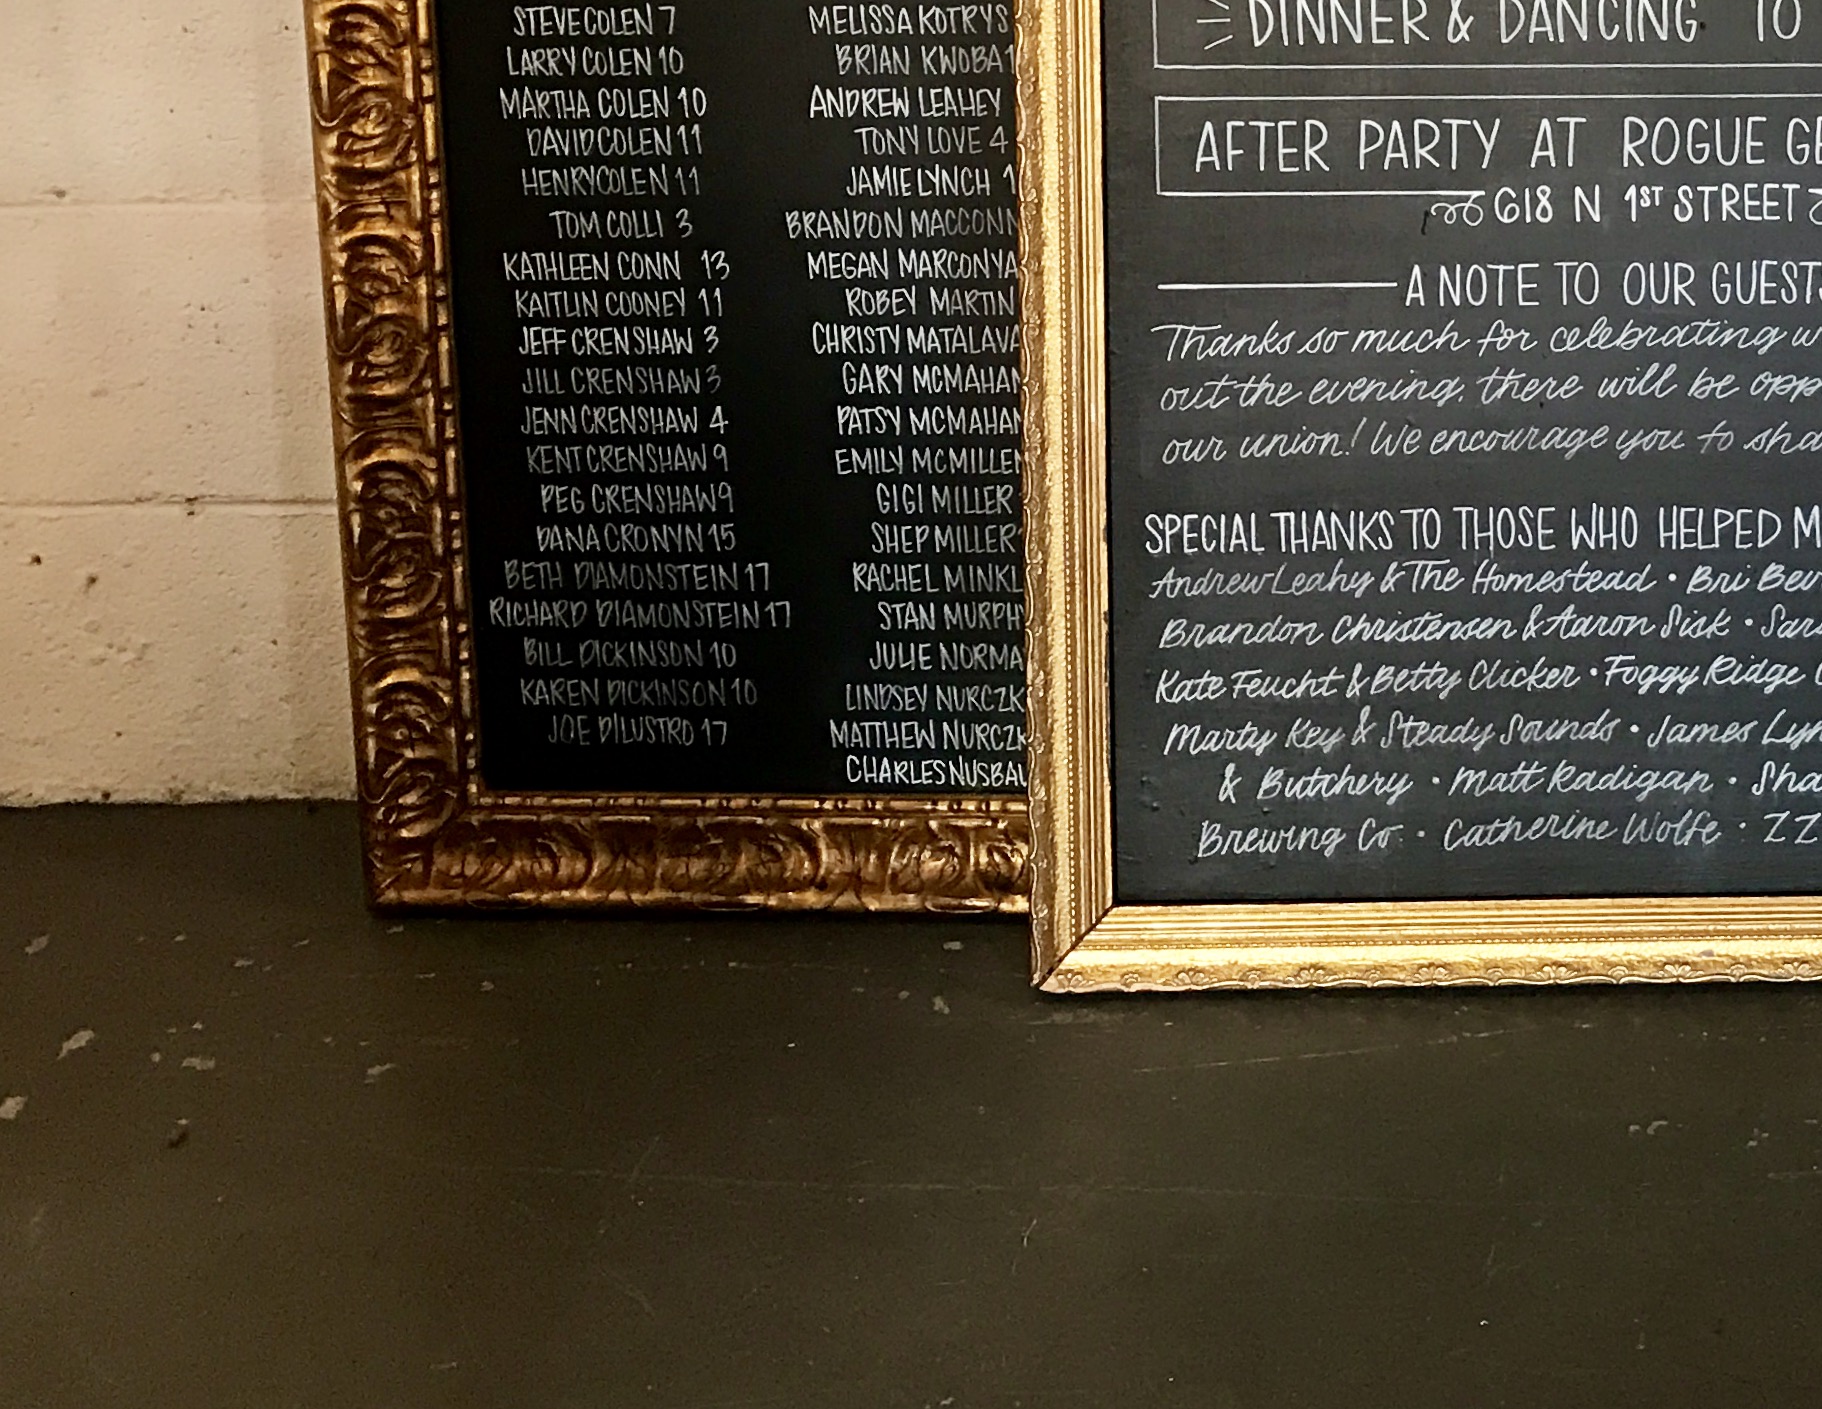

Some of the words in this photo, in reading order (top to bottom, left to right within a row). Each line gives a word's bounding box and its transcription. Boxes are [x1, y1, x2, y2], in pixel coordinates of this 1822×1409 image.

[809, 84, 911, 119] ANDREW
[917, 86, 1002, 119] LEAHEY
[853, 124, 921, 157] TONY
[927, 124, 982, 156] LOVE
[988, 124, 1010, 155] 4
[1194, 119, 1330, 173] AFTER
[1358, 117, 1501, 171] PARTY
[1529, 115, 1589, 170] AT
[1621, 115, 1768, 169] ROGUE
[1493, 185, 1555, 225] 618
[1573, 184, 1603, 224] N
[1622, 184, 1665, 223] 1ST
[1674, 182, 1801, 223] STREET
[502, 249, 610, 282] KATHLEEN
[616, 249, 682, 282] CONN
[700, 248, 731, 282] 13
[1404, 263, 1425, 308] A
[1437, 262, 1541, 308] NOTE
[1553, 260, 1601, 307] TO
[1622, 260, 1697, 307] OUR
[1150, 319, 1297, 362] Thanks
[1296, 327, 1350, 357] so
[1350, 318, 1471, 354] much
[1476, 318, 1539, 359] for
[1549, 315, 1788, 356] celebrating
[1160, 373, 1240, 411] out
[1234, 372, 1303, 408] the
[1477, 364, 1585, 404] there
[1597, 361, 1680, 400] will
[1686, 367, 1739, 400] be
[1161, 434, 1228, 466] our
[1239, 416, 1368, 459] union!
[1370, 420, 1424, 458] We
[1428, 424, 1610, 461] encourage
[1614, 424, 1686, 461] you
[1696, 419, 1736, 456] to
[1144, 512, 1266, 555] SPECIAL
[1269, 509, 1396, 555] THANKS
[1399, 506, 1443, 551] TO
[1452, 505, 1557, 554] THOSE
[1570, 501, 1639, 552] WHO
[1657, 505, 1783, 551] HELPED
[488, 596, 589, 629] RICHARD
[596, 598, 761, 629] DIAMONSTEIN
[763, 599, 792, 629] 17
[1153, 668, 1229, 705] Kate
[1229, 667, 1347, 700] Feucht
[1344, 661, 1370, 699] &
[1367, 659, 1464, 700] Betty
[1467, 656, 1583, 692] Clicker
[1602, 652, 1700, 695] Foggy
[1701, 652, 1808, 695] Ridge
